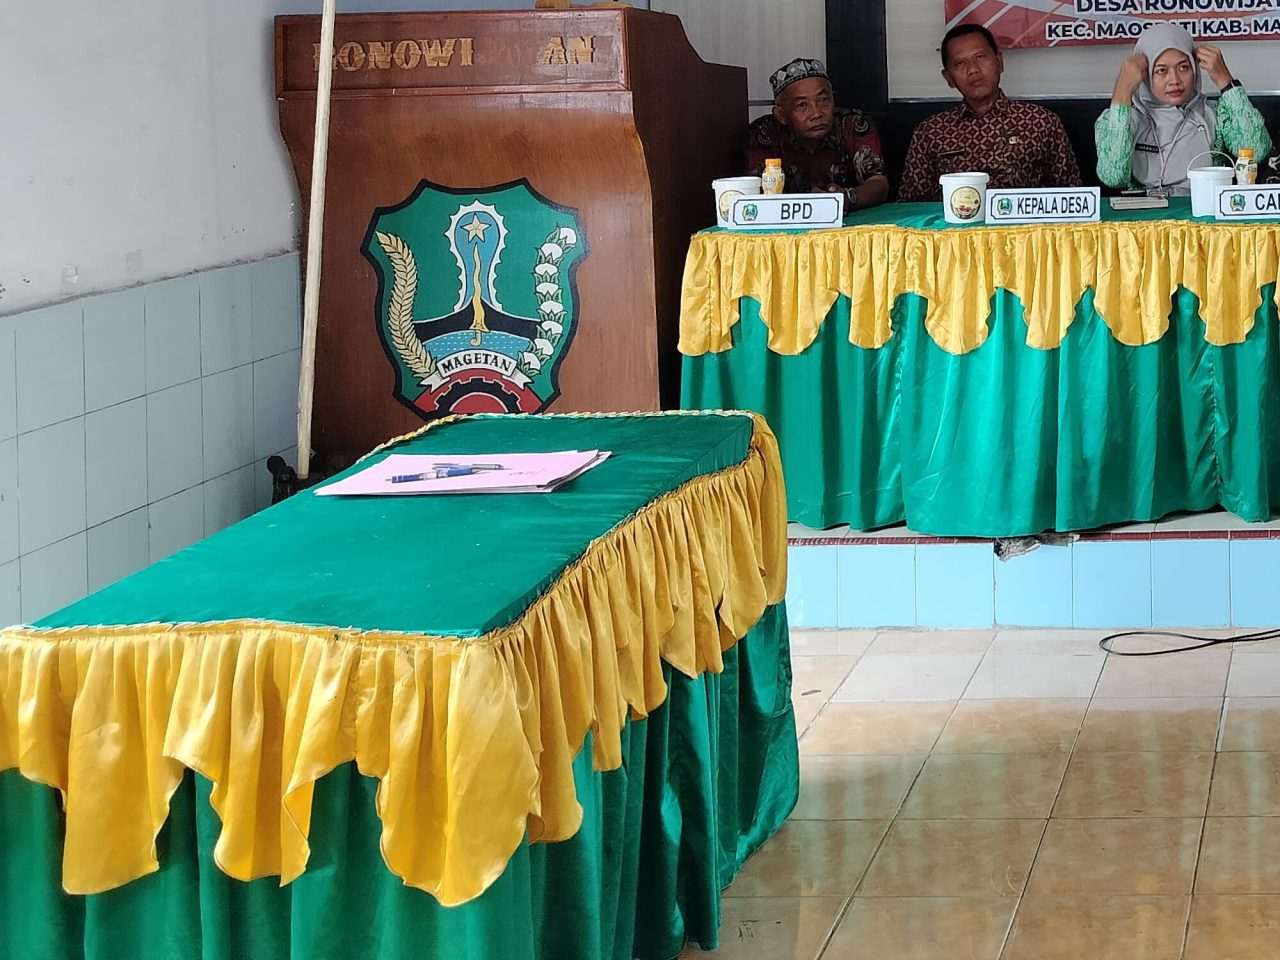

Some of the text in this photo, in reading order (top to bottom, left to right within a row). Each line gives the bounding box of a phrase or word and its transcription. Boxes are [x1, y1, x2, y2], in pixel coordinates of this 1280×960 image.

[1047, 23, 1092, 38] KEC.
[1203, 19, 1248, 35] KAB.
[780, 202, 813, 220] BPD
[1017, 196, 1090, 215] KEPALA DESA
[442, 351, 512, 374] MAGETAN
